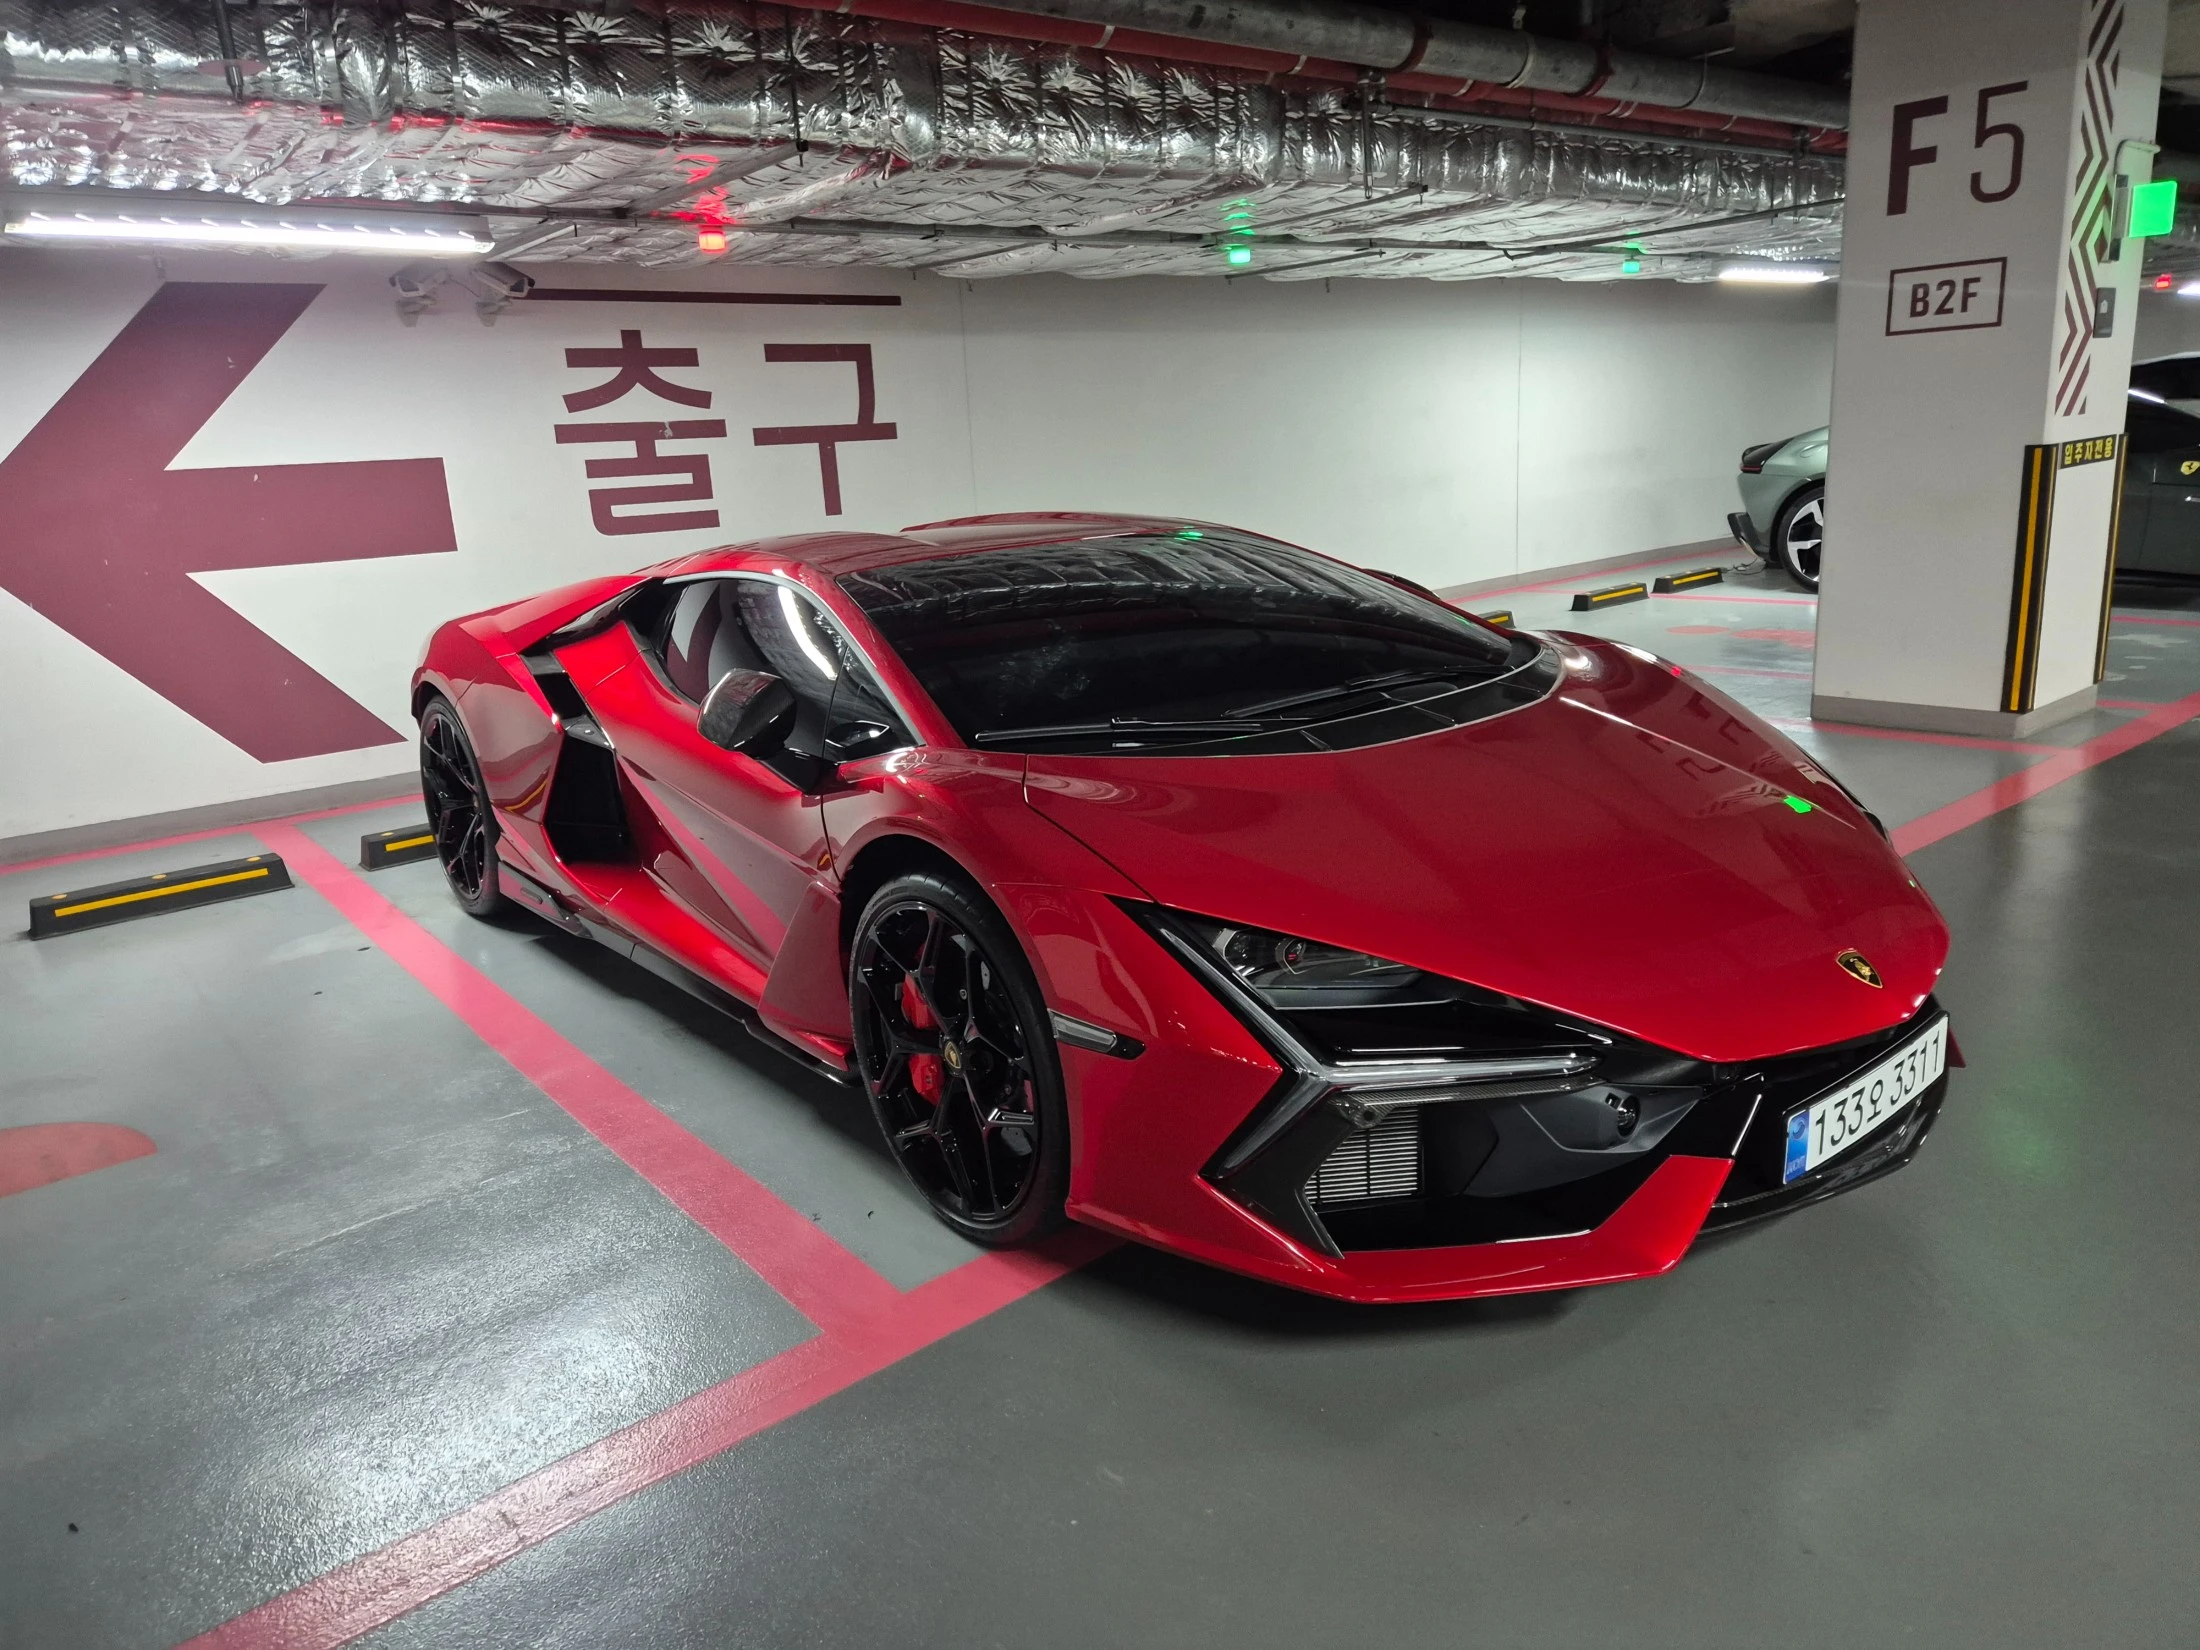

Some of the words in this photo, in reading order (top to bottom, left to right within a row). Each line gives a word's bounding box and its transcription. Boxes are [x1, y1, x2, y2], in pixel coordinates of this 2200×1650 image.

[1909, 277, 1982, 318] B2F
[554, 329, 898, 537] 출구
[2063, 436, 2114, 466] 입주자전용
[1815, 1079, 1884, 1156] 133오
[1890, 1030, 1941, 1106] 3311
